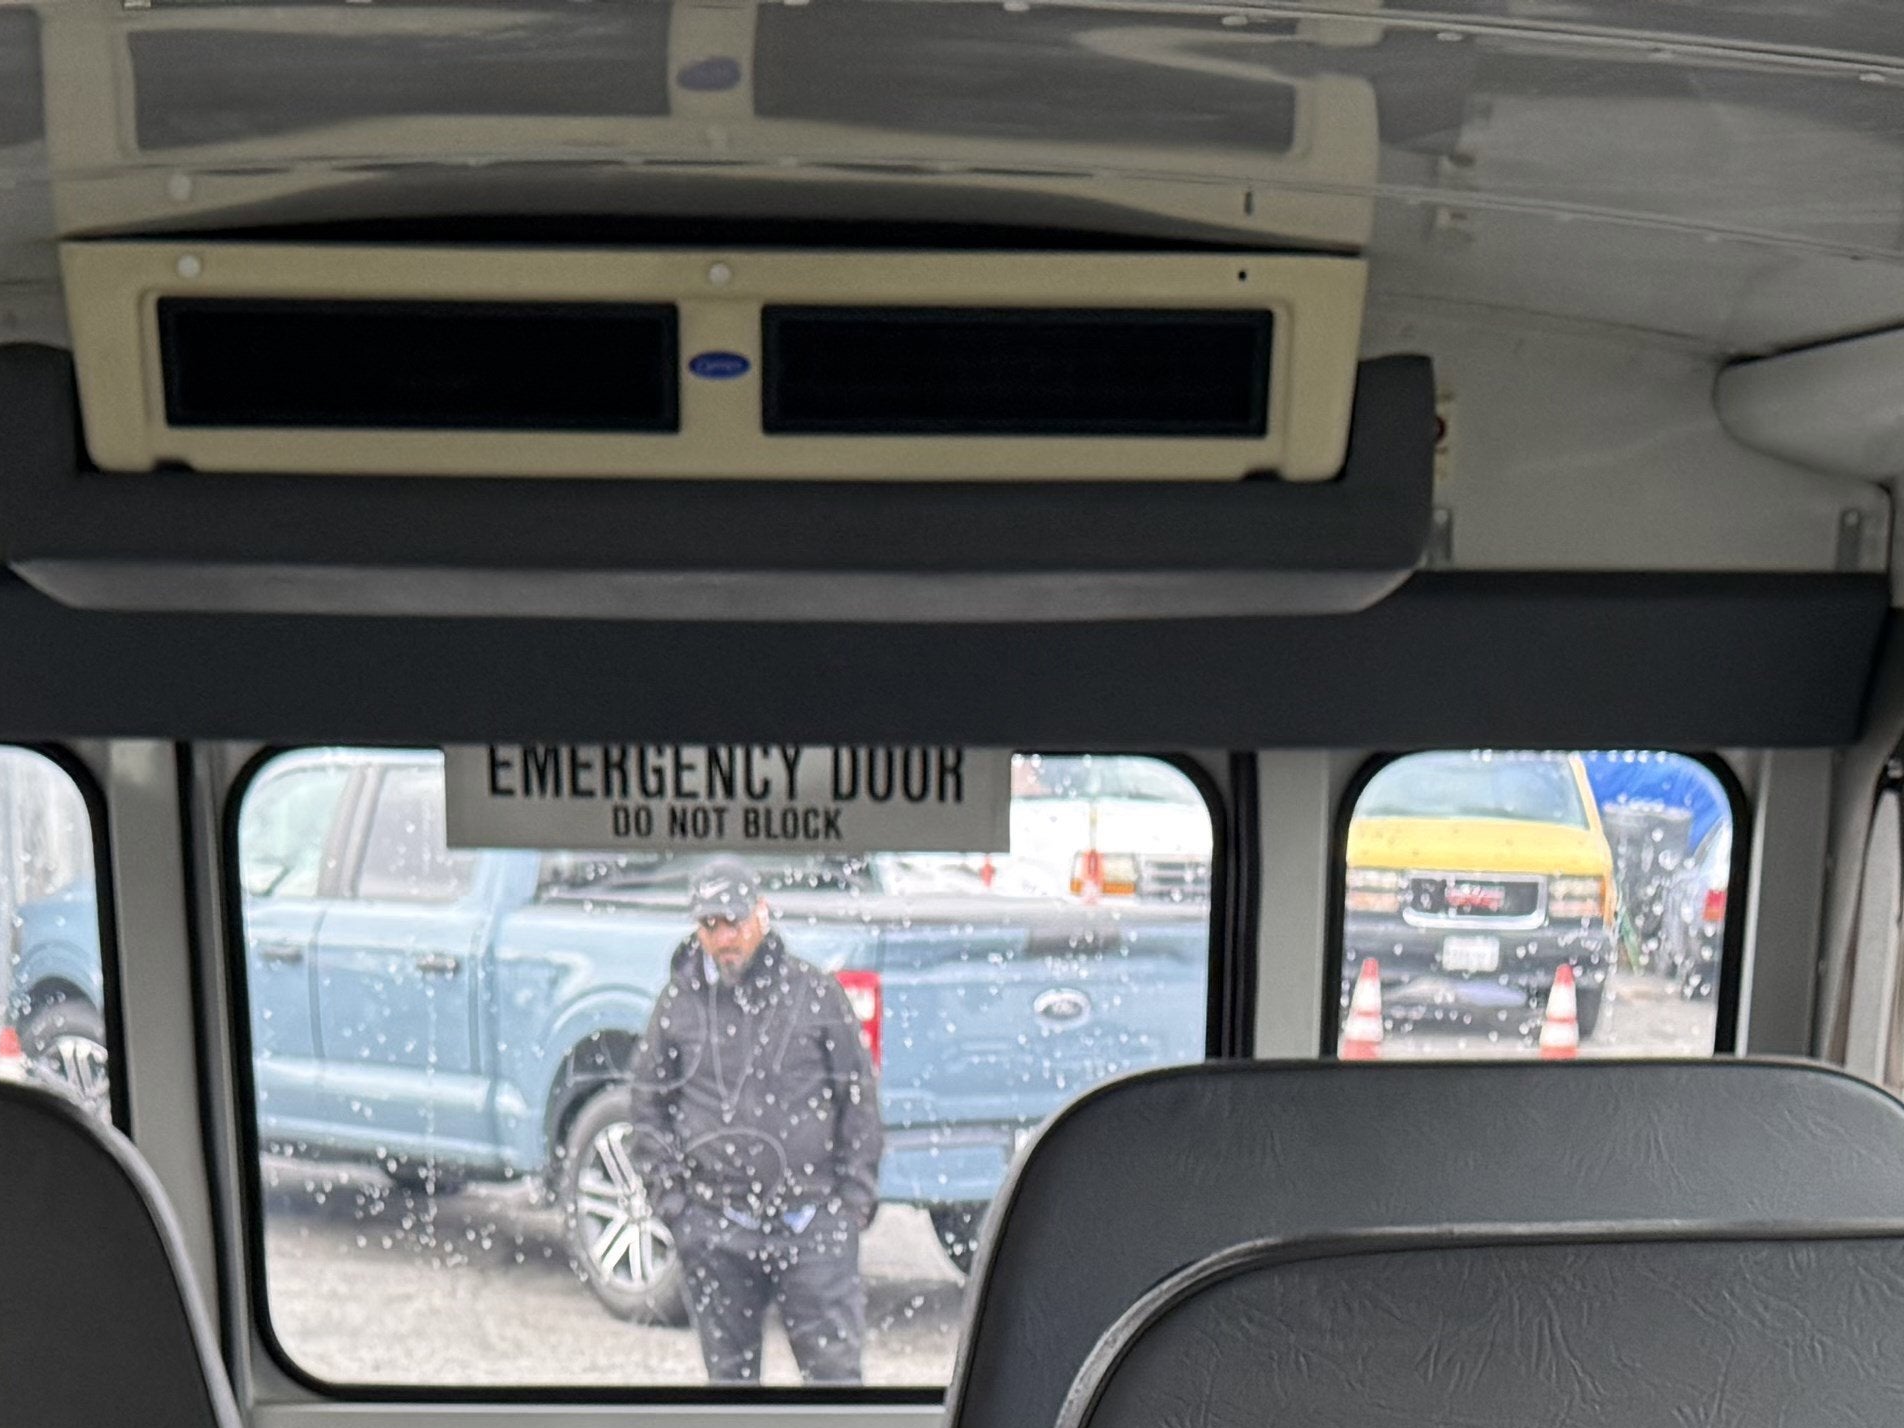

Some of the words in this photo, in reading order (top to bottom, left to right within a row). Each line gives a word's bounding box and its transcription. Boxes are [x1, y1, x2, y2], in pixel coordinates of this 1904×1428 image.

[489, 745, 799, 800] EMERGENCY
[612, 804, 653, 838] DO
[669, 805, 729, 840] NOT
[744, 807, 844, 840] BLOCK
